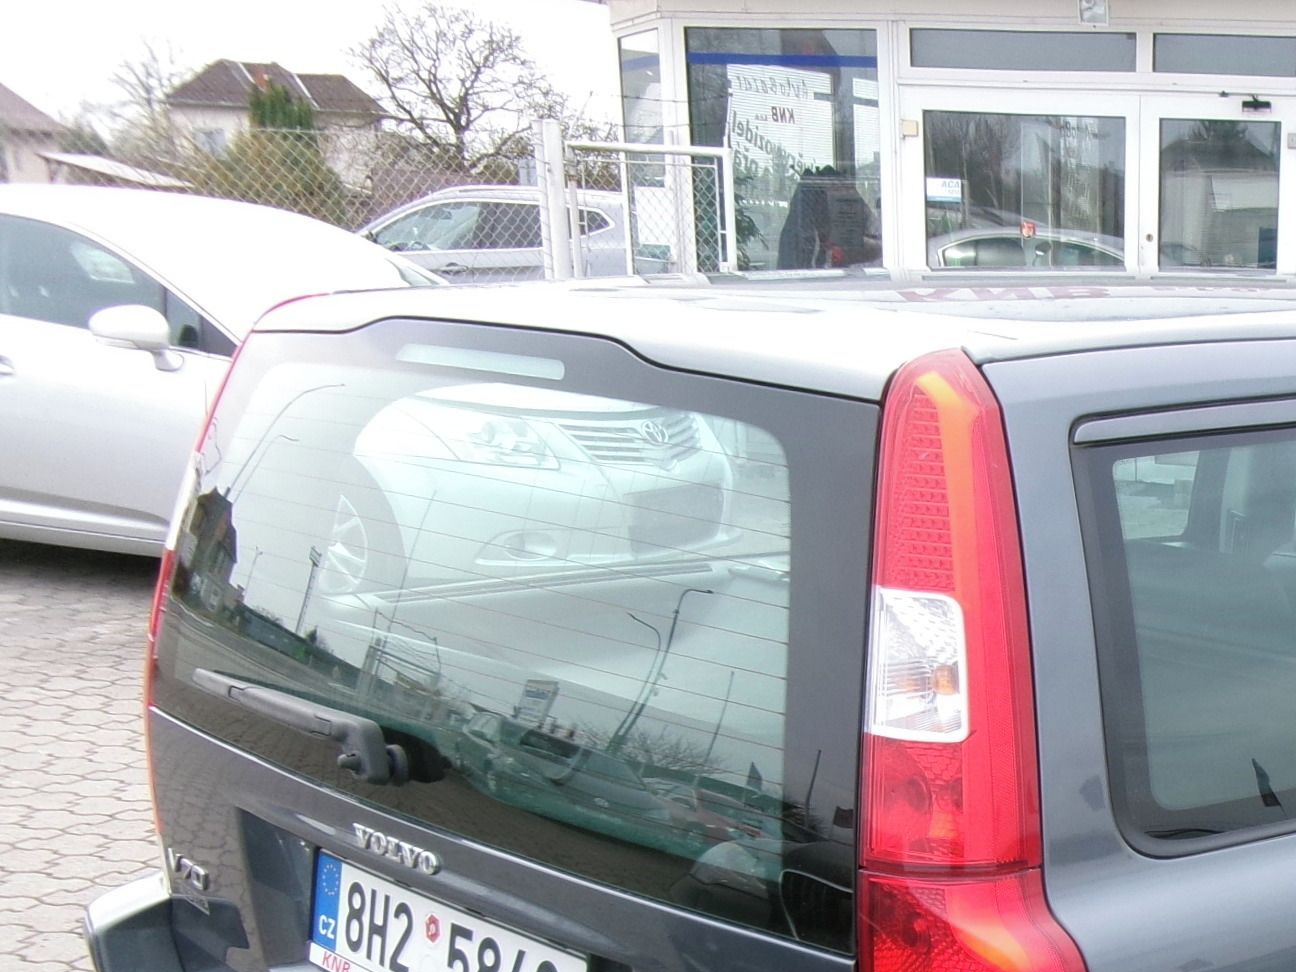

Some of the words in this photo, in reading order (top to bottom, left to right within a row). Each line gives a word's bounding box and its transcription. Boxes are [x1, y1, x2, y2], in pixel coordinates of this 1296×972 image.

[167, 847, 208, 891] V70
[352, 822, 437, 875] VOLVO
[319, 914, 336, 939] CZ
